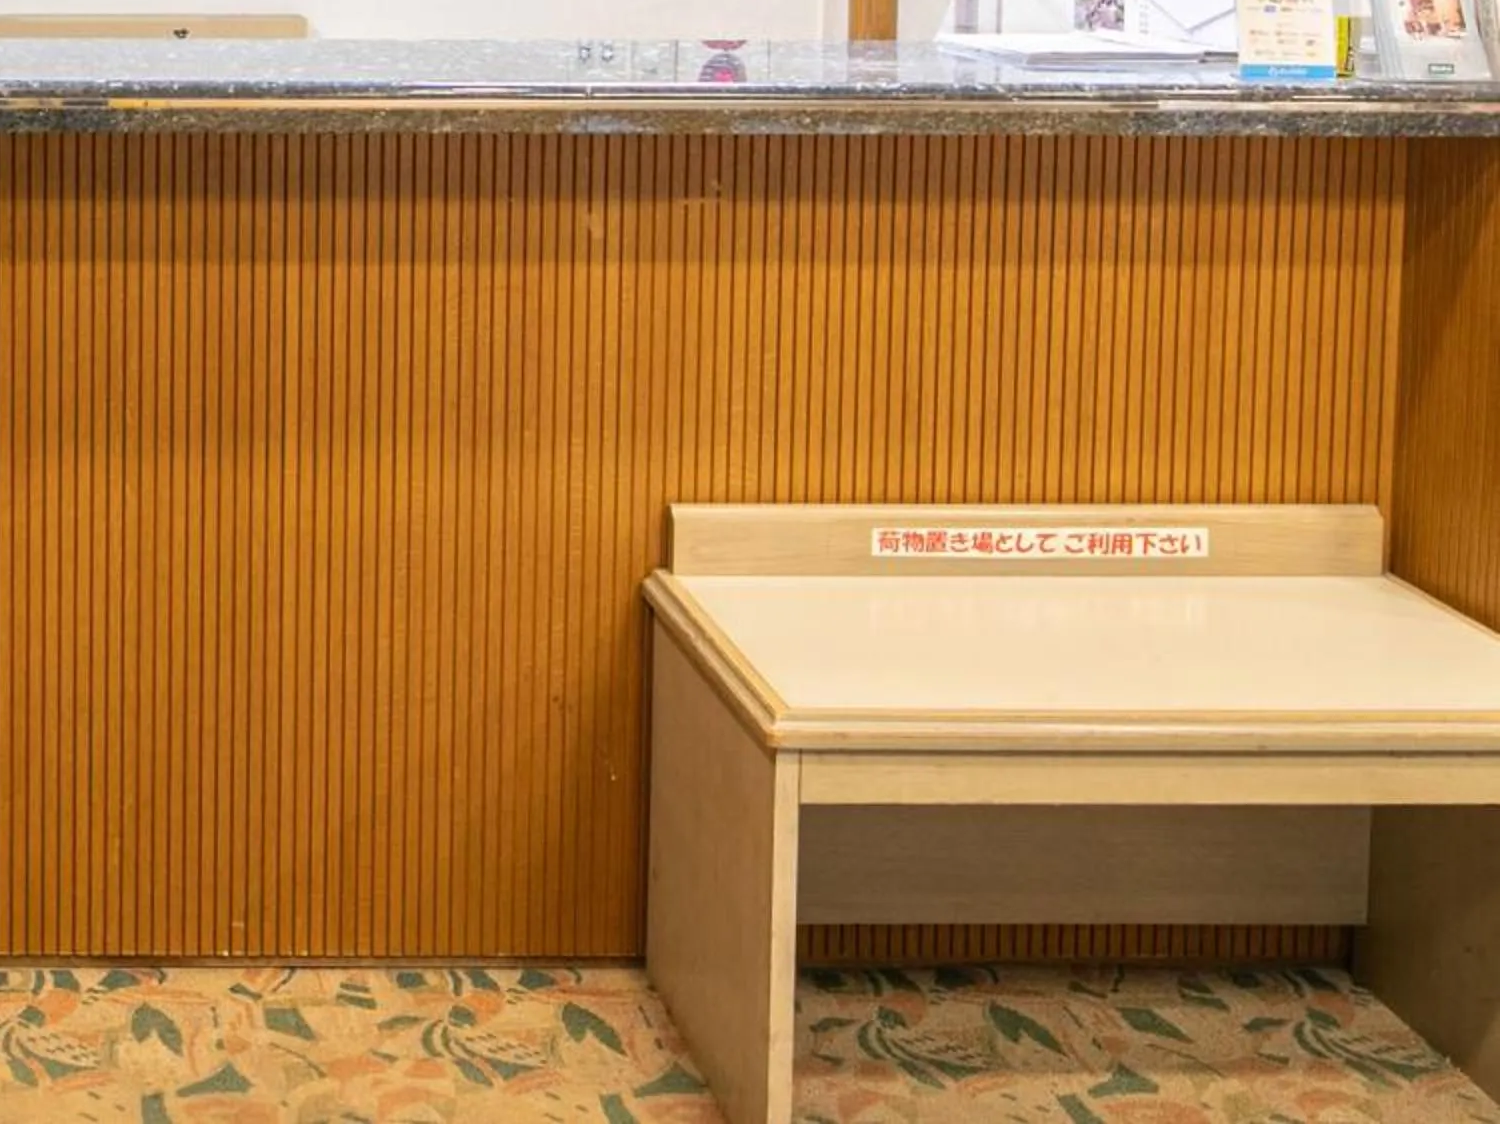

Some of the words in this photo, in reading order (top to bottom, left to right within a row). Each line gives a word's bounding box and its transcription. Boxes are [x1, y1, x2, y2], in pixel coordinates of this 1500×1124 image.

[877, 531, 1202, 556] 荷物置き場としてご利用下さい
